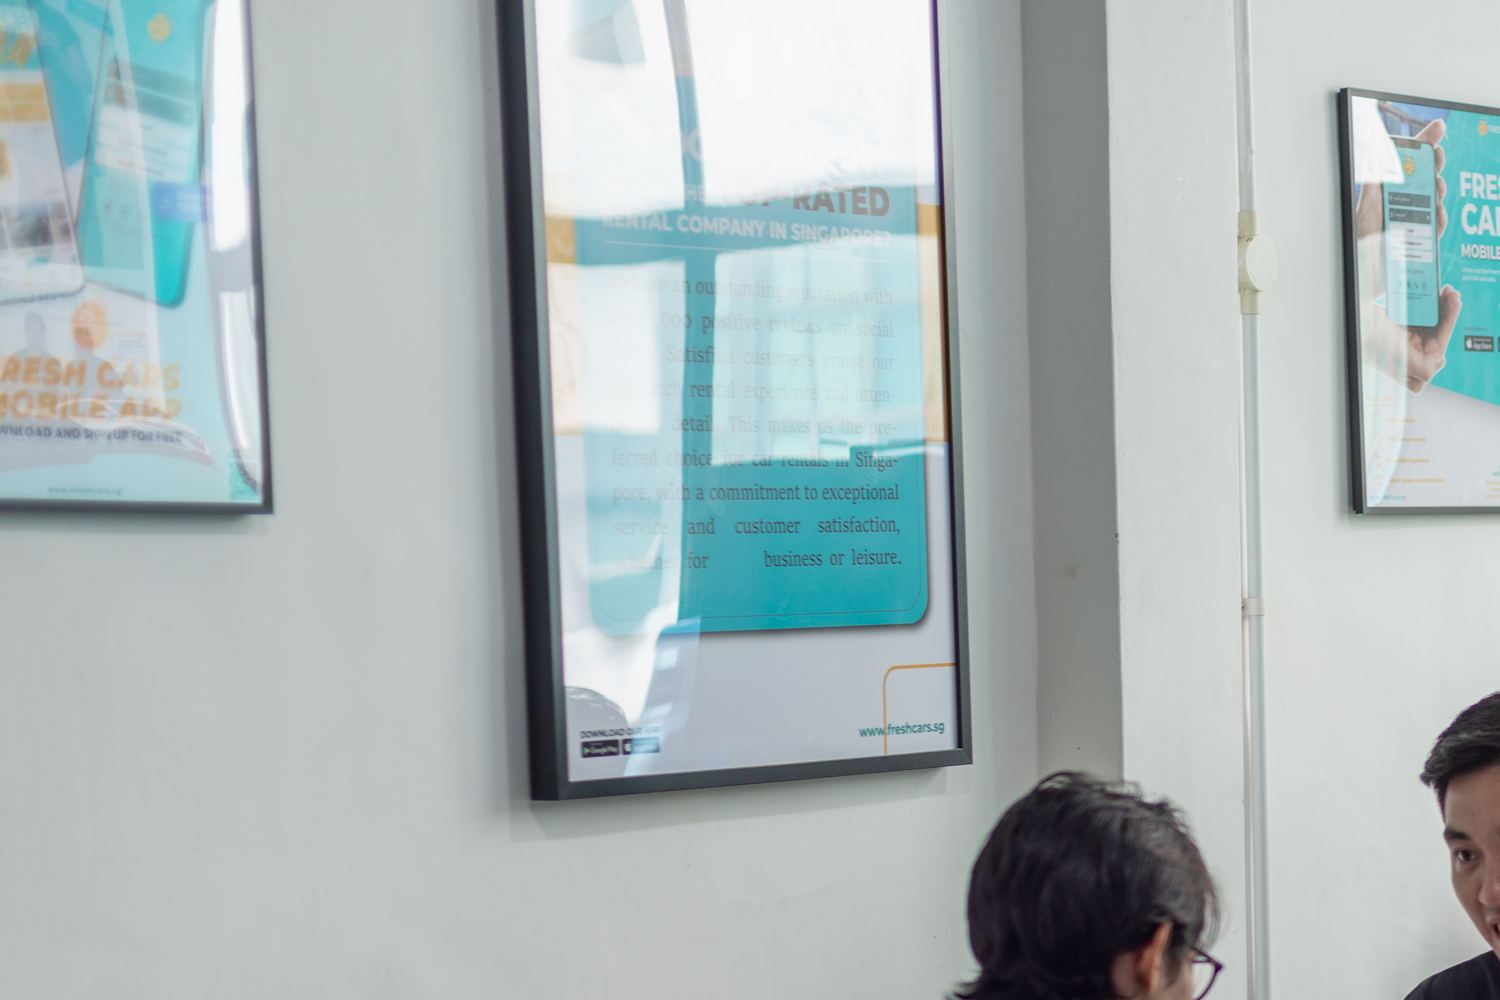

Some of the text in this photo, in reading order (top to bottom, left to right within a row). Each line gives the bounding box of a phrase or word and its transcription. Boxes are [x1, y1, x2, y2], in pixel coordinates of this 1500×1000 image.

[717, 173, 890, 217] TOP-RATED
[602, 210, 891, 248] RENTAL COMPANY IN SINGAPORE?
[632, 271, 667, 293] have
[672, 279, 692, 294] an
[694, 279, 783, 303] outstanding
[787, 282, 860, 306] reputation
[863, 288, 894, 306] with
[702, 313, 761, 334] positive
[768, 317, 822, 335] reviews
[830, 321, 848, 336] on
[856, 321, 895, 338] social
[666, 345, 735, 365] Satisfied
[742, 348, 815, 368] customers
[822, 352, 865, 372] praise
[872, 356, 896, 371] our
[0, 355, 180, 391] RESH CARS
[689, 380, 736, 399] rental
[742, 385, 818, 404] experience
[824, 383, 850, 402] and
[856, 386, 897, 403] atten-
[115, 396, 182, 425] APP
[55, 427, 81, 439] AND
[113, 430, 129, 441] UP
[131, 430, 153, 442] FOR
[671, 414, 720, 433] detail.
[728, 415, 761, 433] This
[767, 417, 811, 434] makes
[818, 421, 834, 434] us
[841, 418, 863, 435] the
[869, 423, 898, 439] pre-
[610, 449, 899, 472] ferred choice for car rentals in Singa-
[46, 485, 122, 496] www.freshcars.sg
[612, 484, 900, 504] pore, with a commitment to exceptional
[614, 516, 901, 536] service and customer satisfaction,
[615, 549, 903, 571] whether for business or leisure.
[580, 728, 626, 739] DOWNLOAD
[858, 722, 945, 738] www.freshcars.sg
